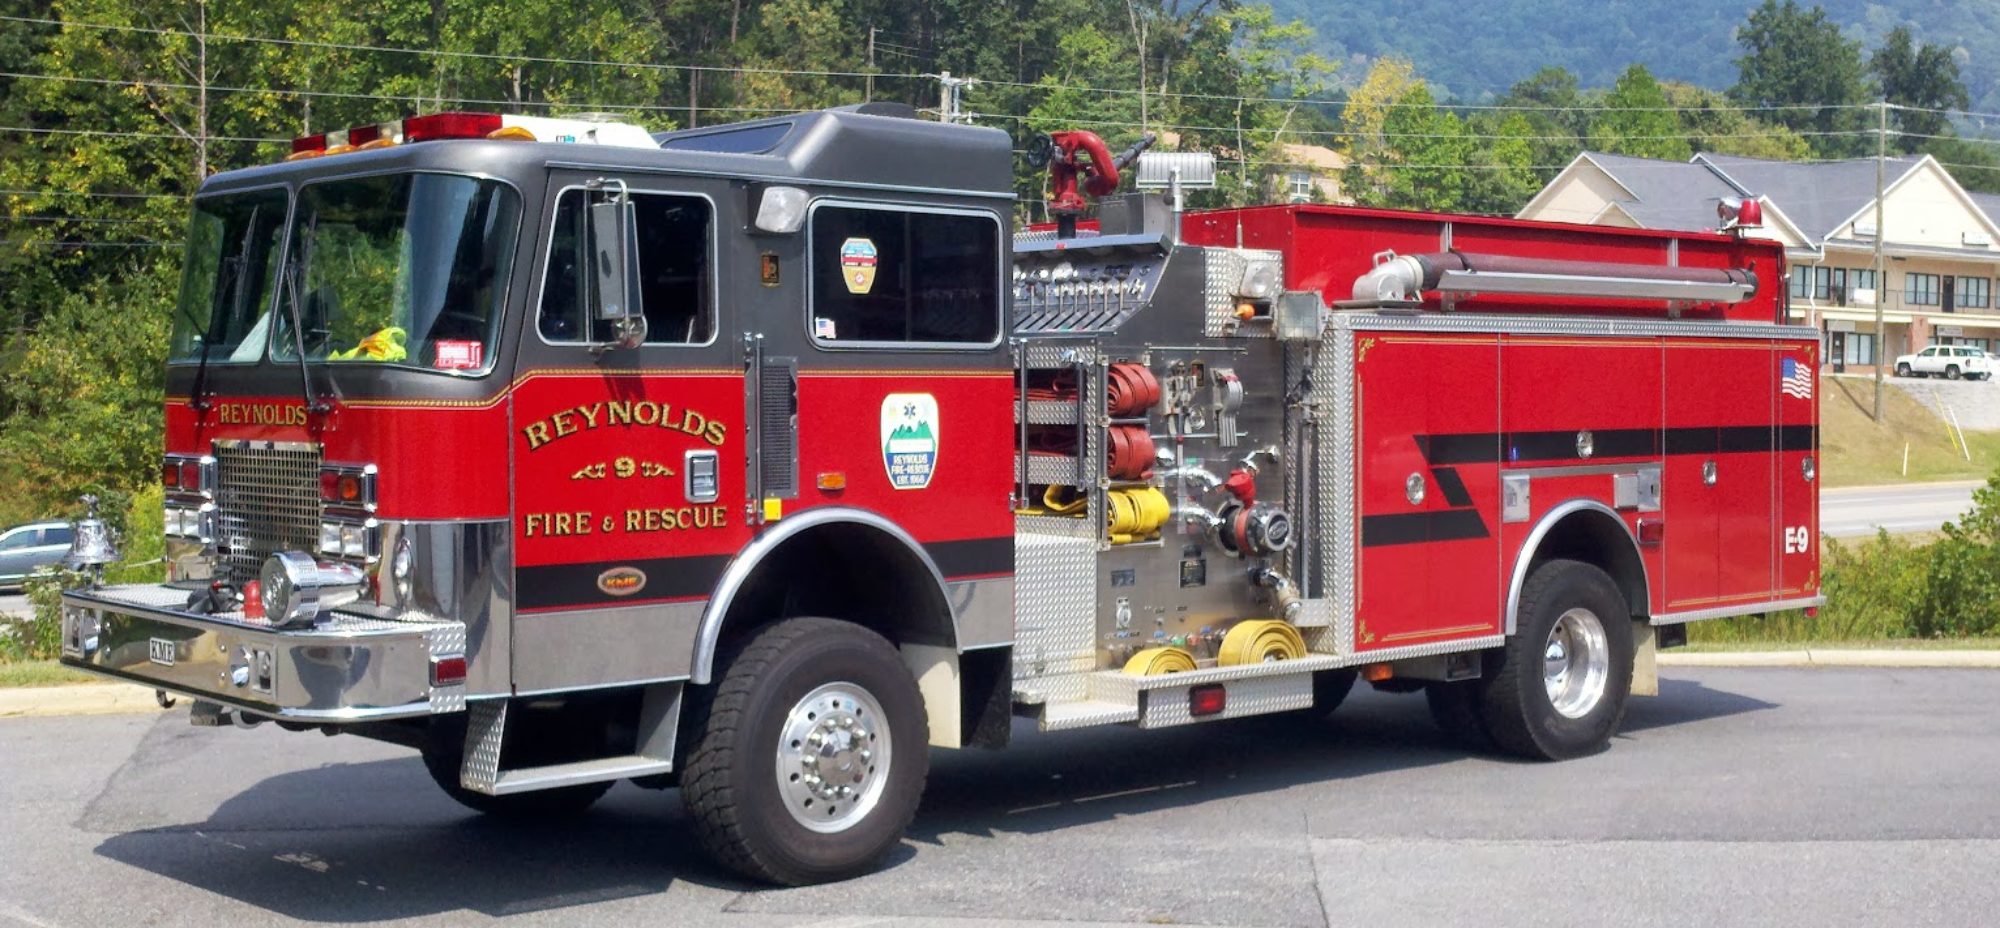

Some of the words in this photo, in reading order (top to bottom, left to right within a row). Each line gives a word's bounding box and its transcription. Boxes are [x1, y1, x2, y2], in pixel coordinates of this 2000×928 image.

[220, 403, 307, 425] REYNOLDS
[522, 400, 727, 450] REYNOLDS
[613, 457, 636, 479] 9
[893, 454, 928, 465] REYNOLDS
[524, 511, 593, 537] FIRE
[602, 516, 615, 532] &
[624, 506, 727, 532] RESCUE
[606, 575, 638, 588] KME
[150, 639, 174, 664] KME
